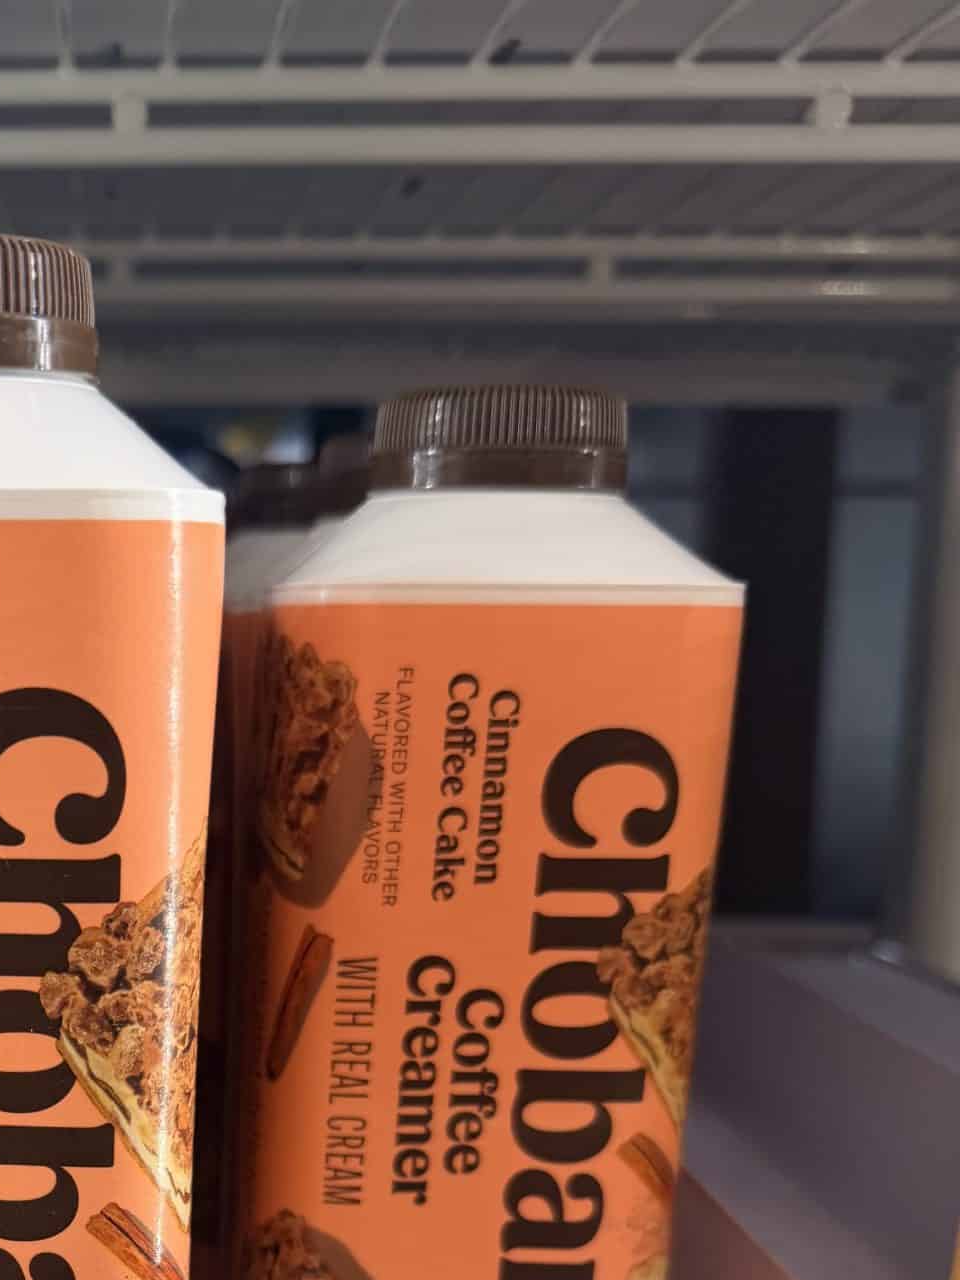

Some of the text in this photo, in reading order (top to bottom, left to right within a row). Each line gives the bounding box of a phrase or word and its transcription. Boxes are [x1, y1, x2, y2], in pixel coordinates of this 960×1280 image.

[381, 666, 415, 907] FLAVORED WITH OTHER
[431, 672, 480, 902] Coffee Cake
[474, 689, 521, 885] Cinnamon
[323, 957, 378, 1206] WITH REAL CREAM
[391, 955, 456, 1206] Creamer
[443, 988, 505, 1175] Coffee
